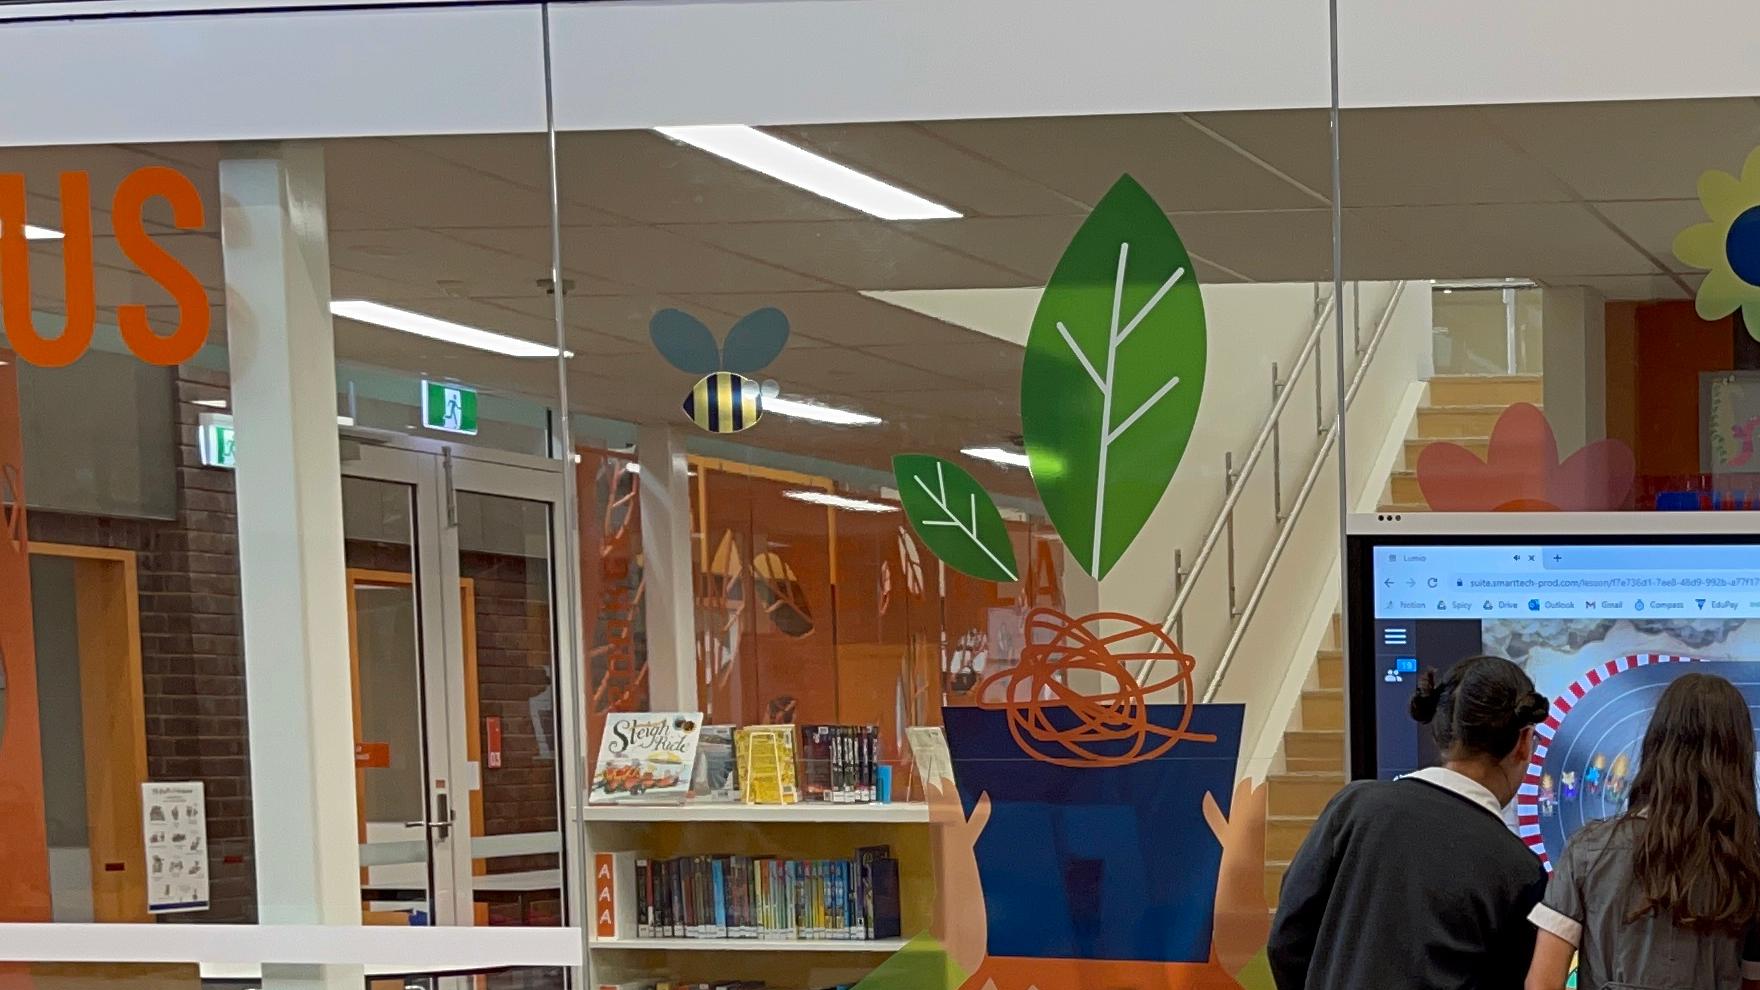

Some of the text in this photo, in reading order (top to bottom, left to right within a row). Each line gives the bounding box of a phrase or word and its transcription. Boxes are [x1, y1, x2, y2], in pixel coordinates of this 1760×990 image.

[0, 166, 211, 368] US
[1499, 600, 1517, 609] Drive
[1545, 600, 1574, 609] Outlook
[1601, 600, 1623, 609] Gmail
[1650, 600, 1684, 610] Compass
